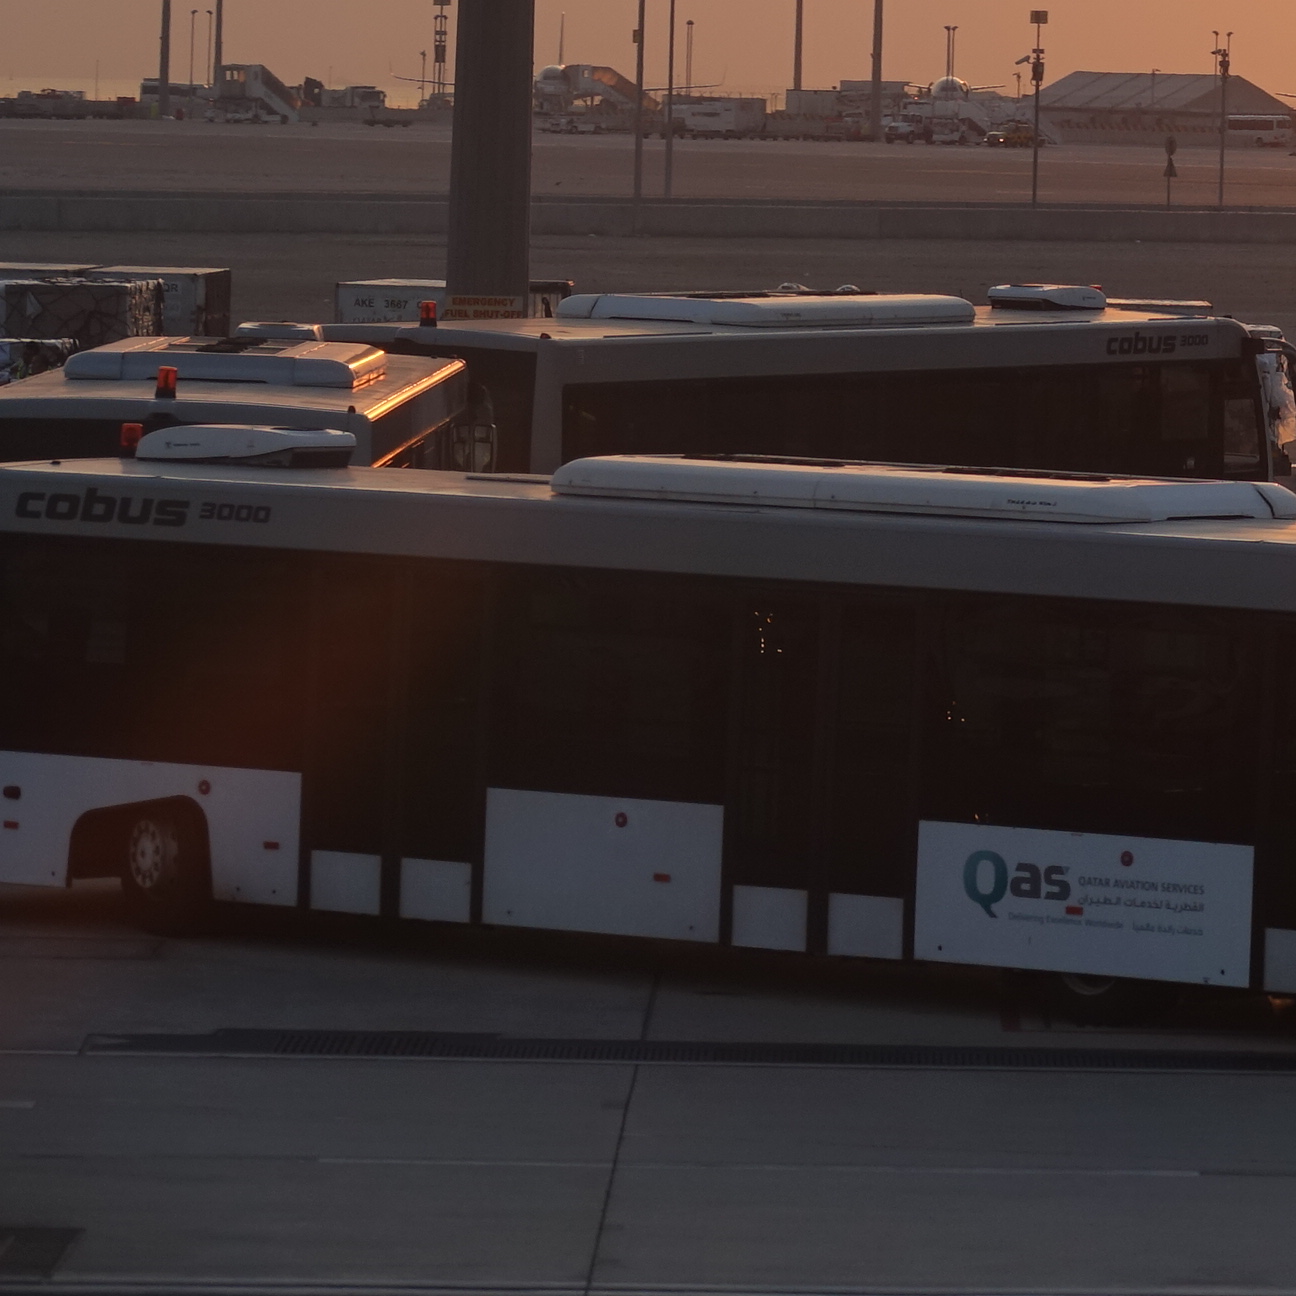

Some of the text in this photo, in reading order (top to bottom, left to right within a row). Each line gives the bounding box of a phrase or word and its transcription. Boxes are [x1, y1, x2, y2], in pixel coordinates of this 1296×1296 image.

[354, 298, 375, 308] AKE
[452, 297, 515, 307] EMERGENCY
[444, 308, 522, 319] FUEL SHUT-OFF
[1106, 331, 1208, 355] cobus 3000
[15, 487, 271, 527] cobus 3000
[963, 850, 1071, 918] Qas
[1078, 876, 1205, 895] QATAR AVIATION SERVICES
[1077, 894, 1122, 907] الطيران
[1165, 901, 1204, 913] القطرية
